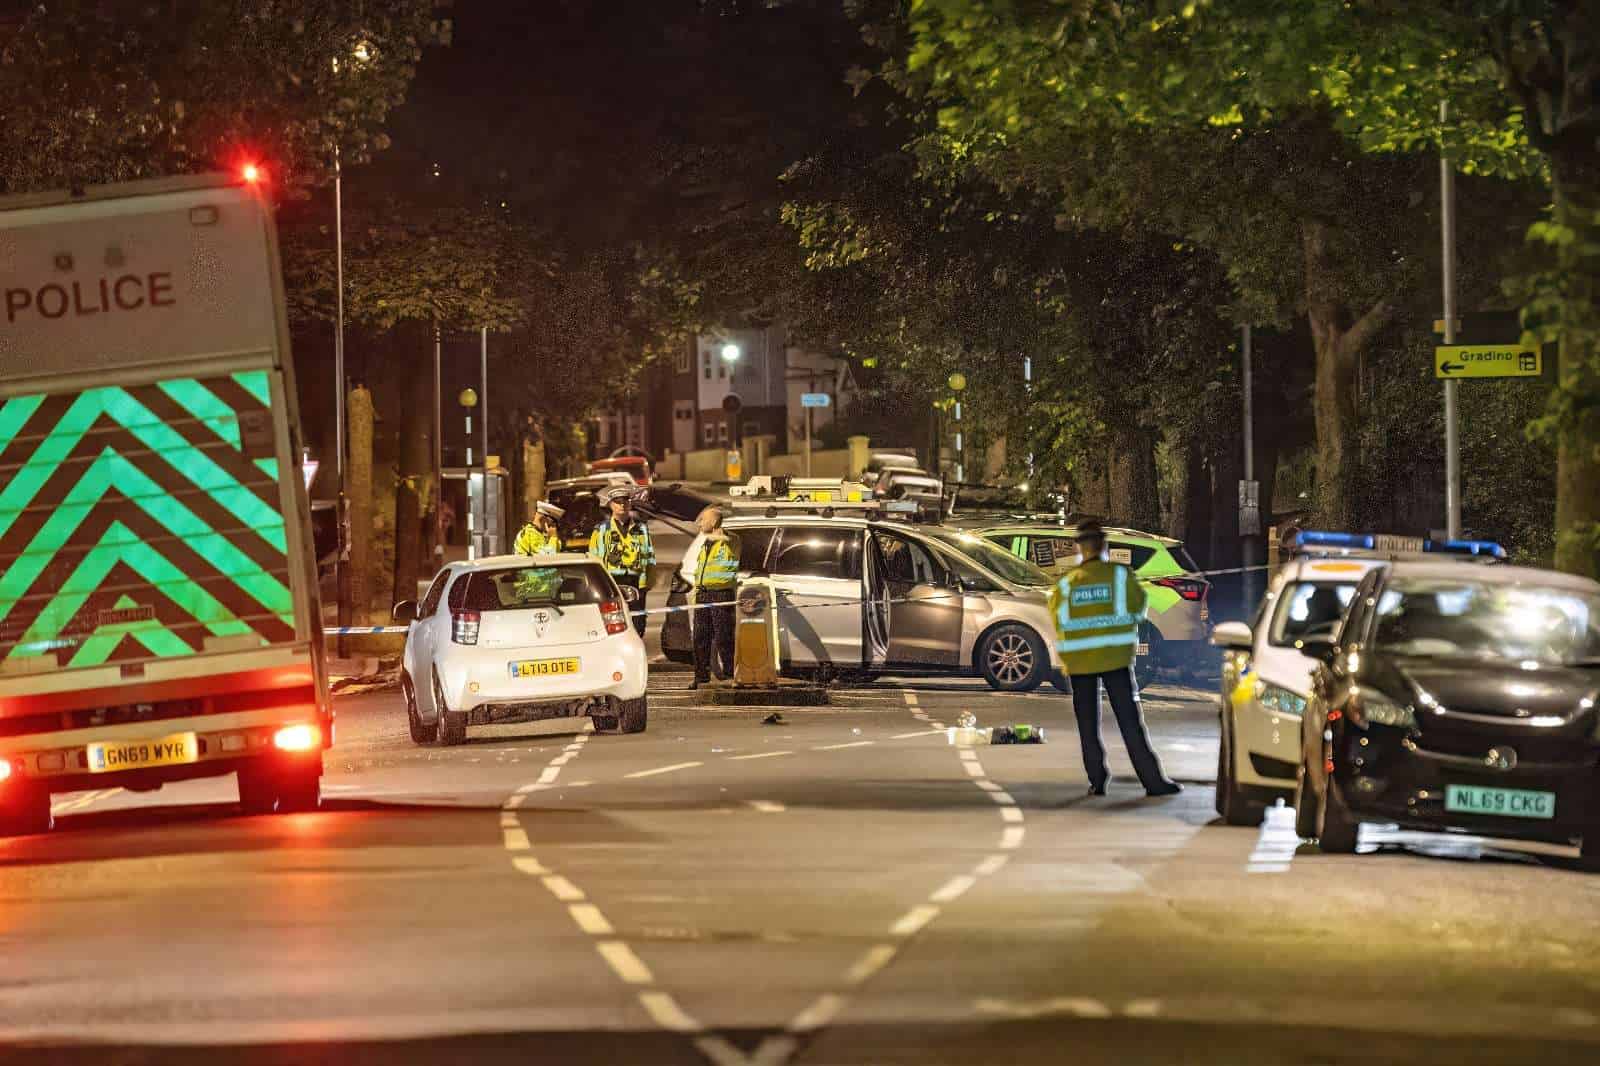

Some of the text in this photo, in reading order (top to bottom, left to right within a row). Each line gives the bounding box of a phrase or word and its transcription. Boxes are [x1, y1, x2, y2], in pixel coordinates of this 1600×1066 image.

[5, 272, 176, 323] POLICE
[1460, 351, 1513, 361] Gradino
[1074, 588, 1109, 600] POLICE
[522, 664, 548, 676] LT13
[107, 743, 185, 765] GN69 WYR
[1457, 790, 1546, 813] NL69 CKG
